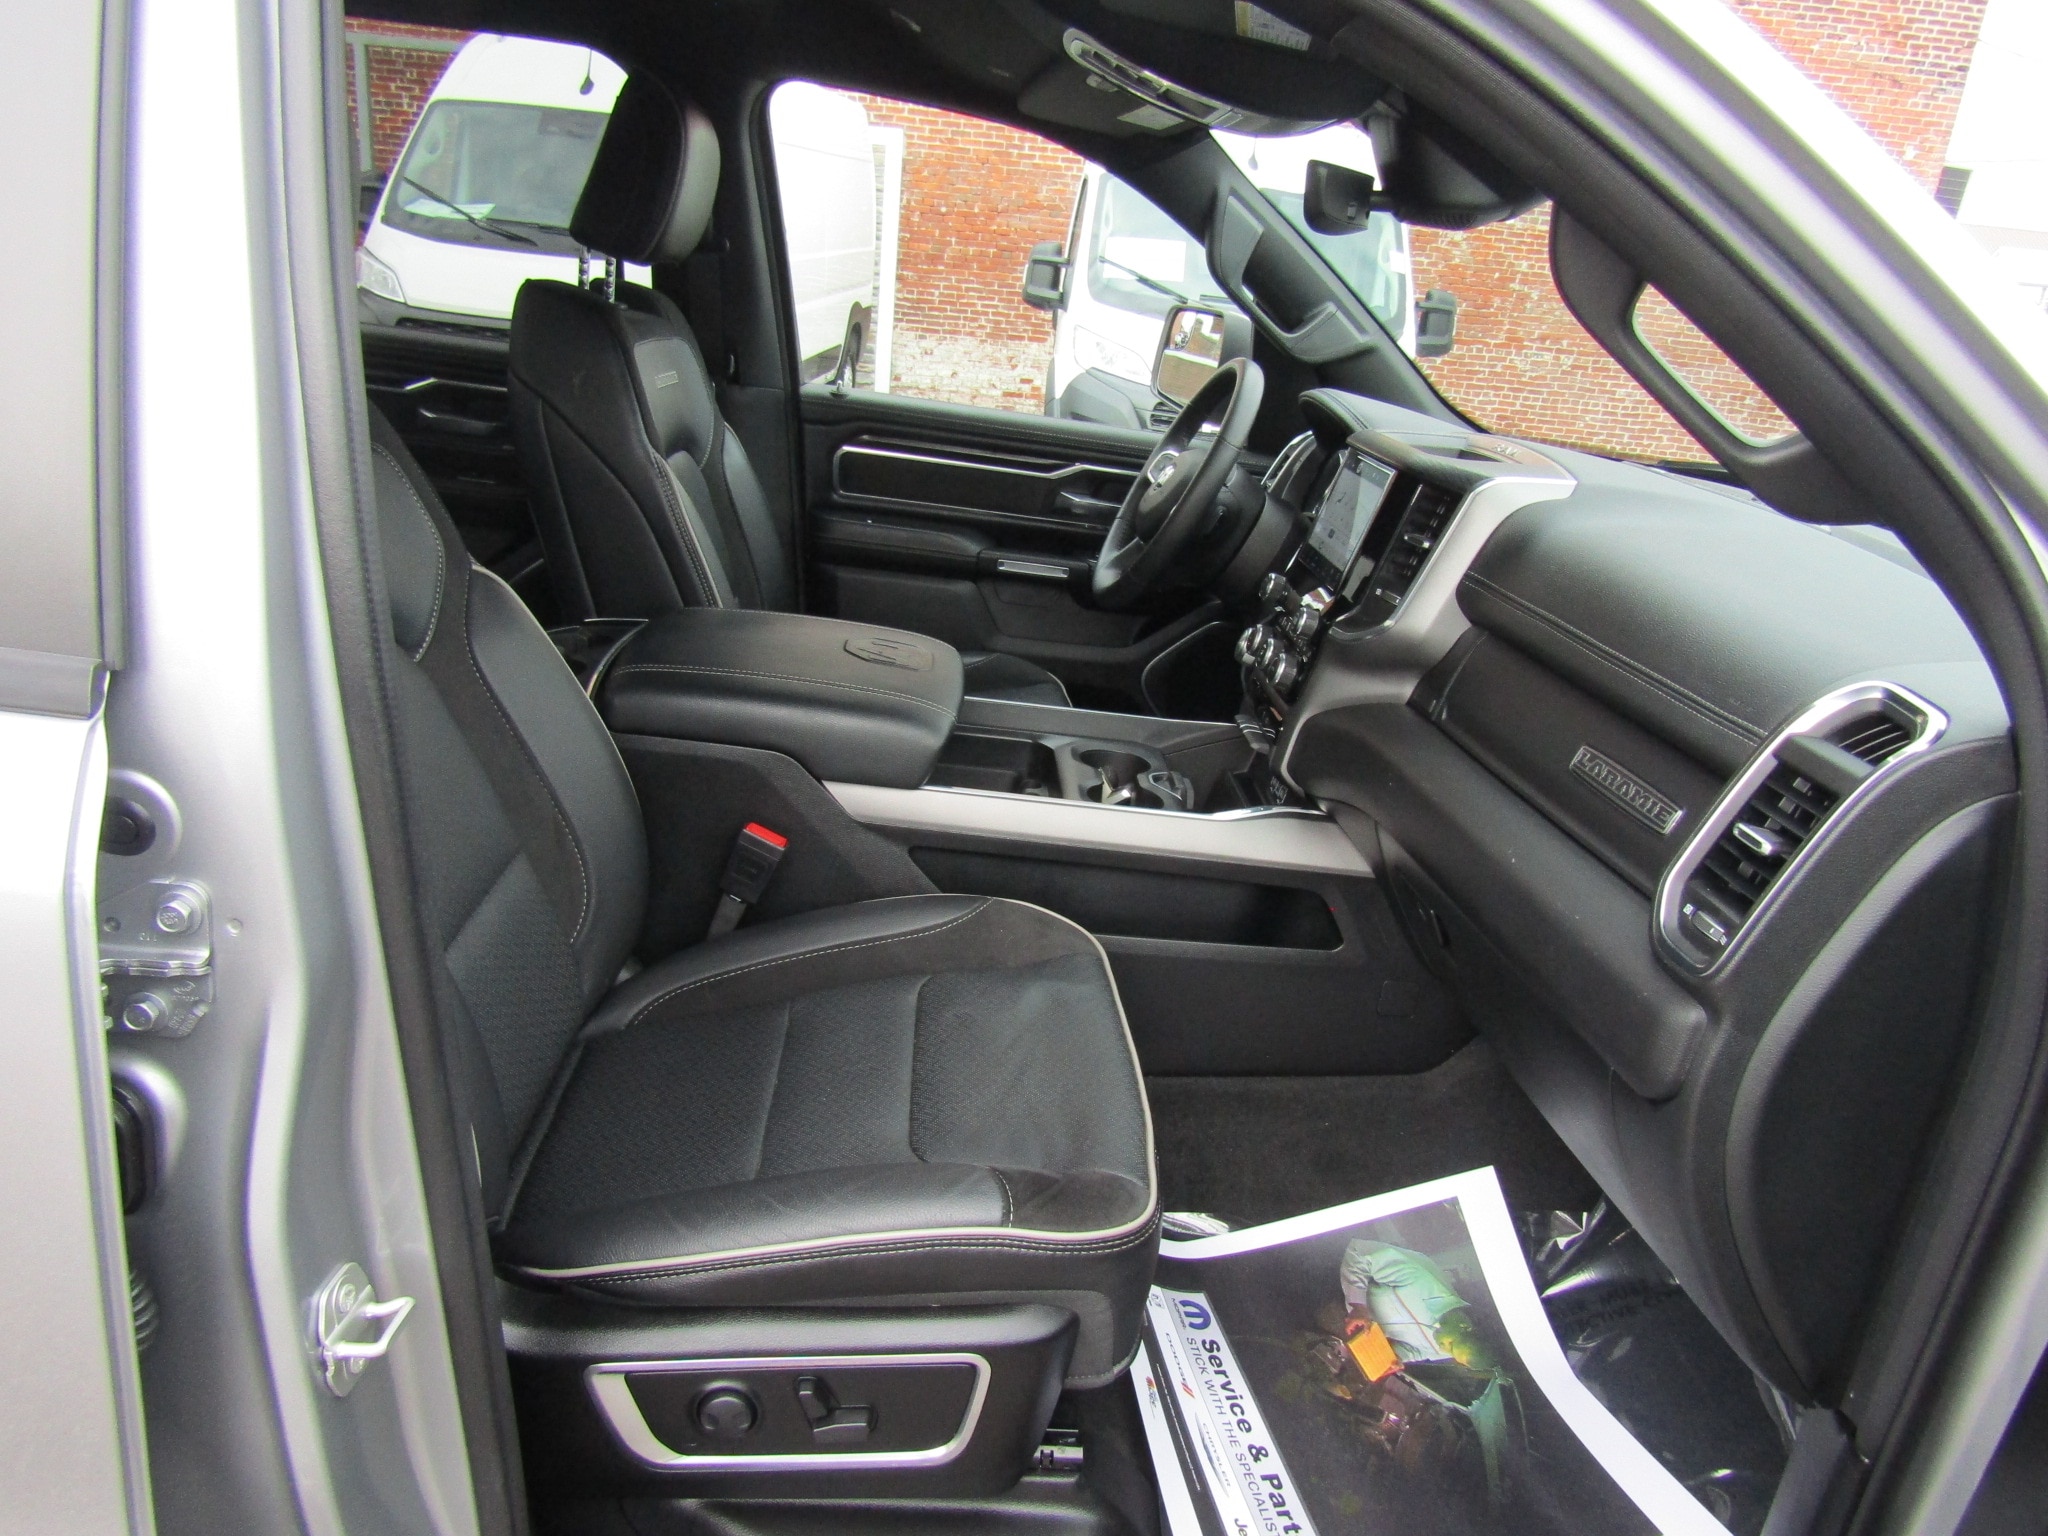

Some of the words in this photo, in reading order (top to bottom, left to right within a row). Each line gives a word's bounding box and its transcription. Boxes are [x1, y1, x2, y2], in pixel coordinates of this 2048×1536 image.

[1573, 750, 1675, 827] LARAMIE
[1166, 1333, 1187, 1383] DODGE
[1186, 1337, 1210, 1375] STICK
[1204, 1380, 1227, 1415] WITH
[1222, 1420, 1242, 1448] THE
[1201, 1339, 1252, 1433] Service
[1247, 1444, 1269, 1463] &
[1203, 1423, 1230, 1487] CHRYSLER
